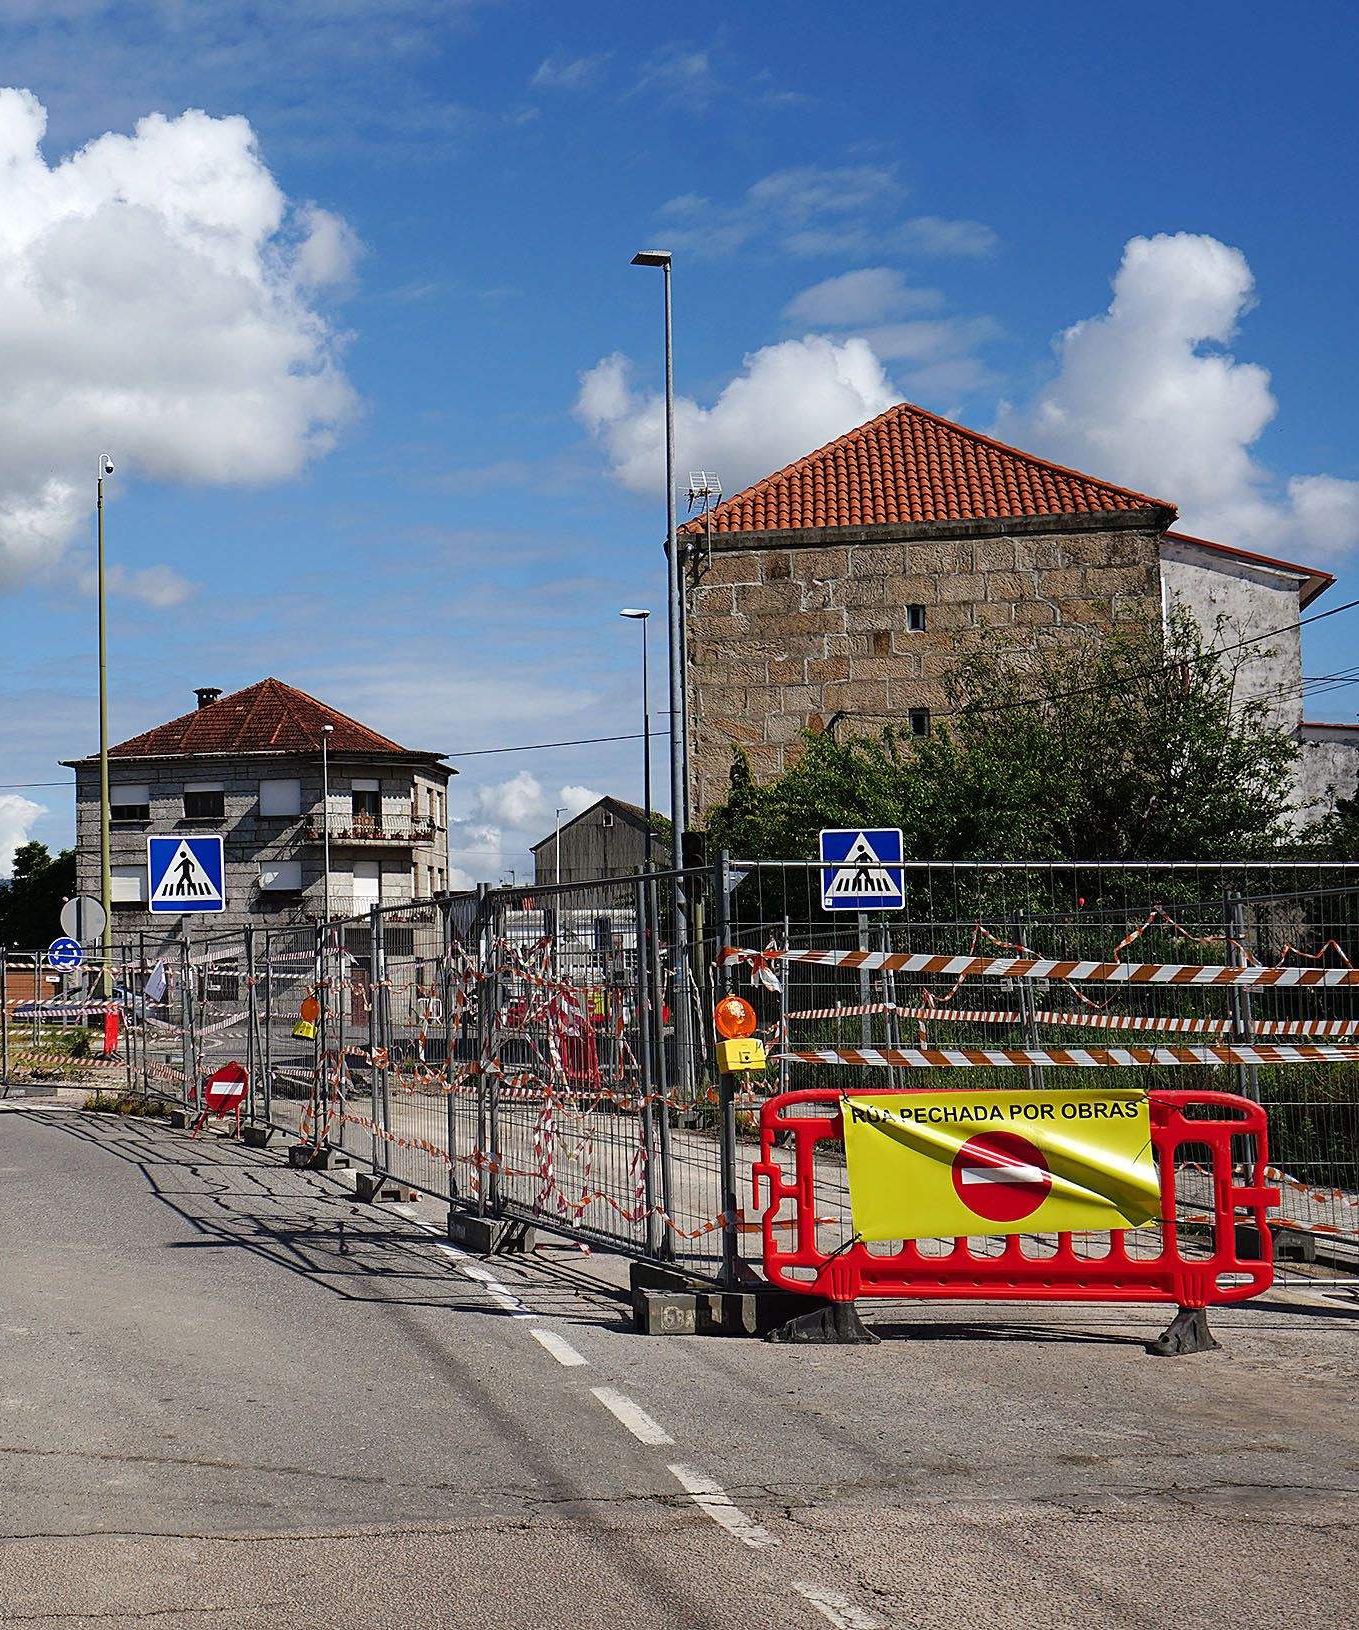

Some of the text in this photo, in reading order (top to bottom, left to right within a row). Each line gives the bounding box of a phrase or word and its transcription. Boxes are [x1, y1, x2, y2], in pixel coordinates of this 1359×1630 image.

[851, 1101, 1140, 1124] RÚA PECHADA POR OBRAS
